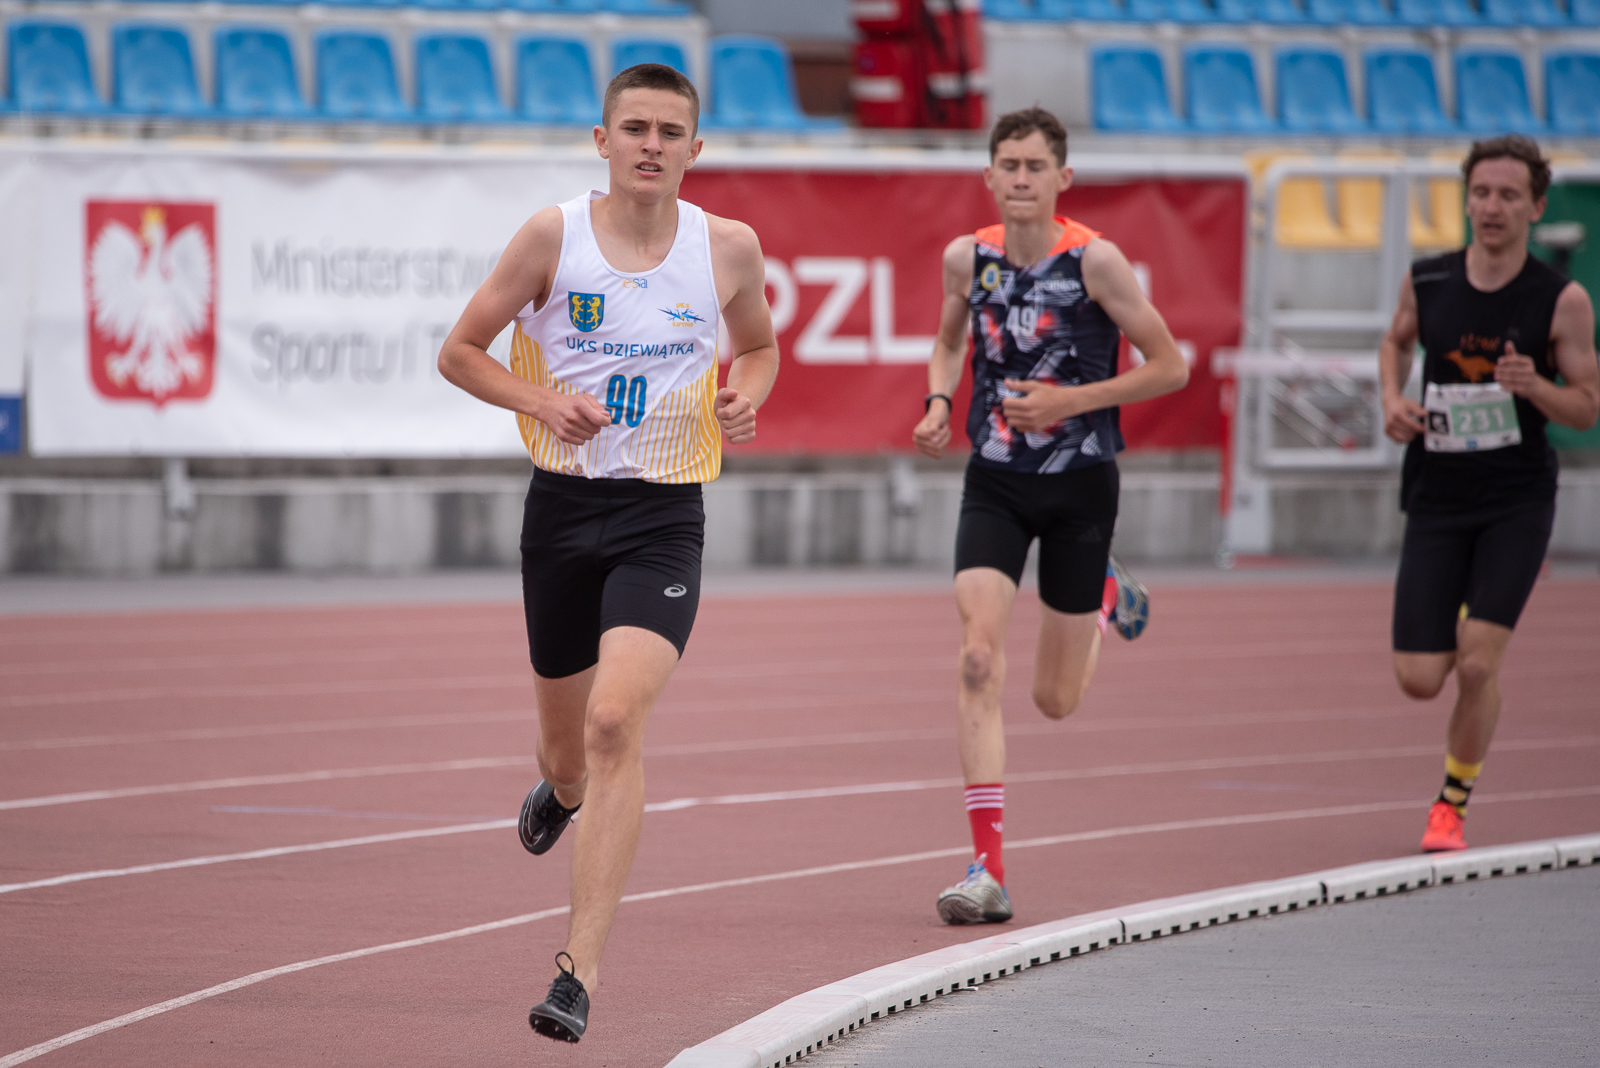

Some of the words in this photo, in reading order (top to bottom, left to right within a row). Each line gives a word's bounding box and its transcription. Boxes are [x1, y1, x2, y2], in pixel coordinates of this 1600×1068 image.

[622, 277, 648, 289] esa
[1005, 305, 1036, 337] 49
[251, 320, 400, 396] Sportu
[566, 336, 598, 354] UKS
[603, 342, 694, 359] DZIEWIĄTKA
[605, 374, 648, 429] 90
[1459, 407, 1505, 433] 231
